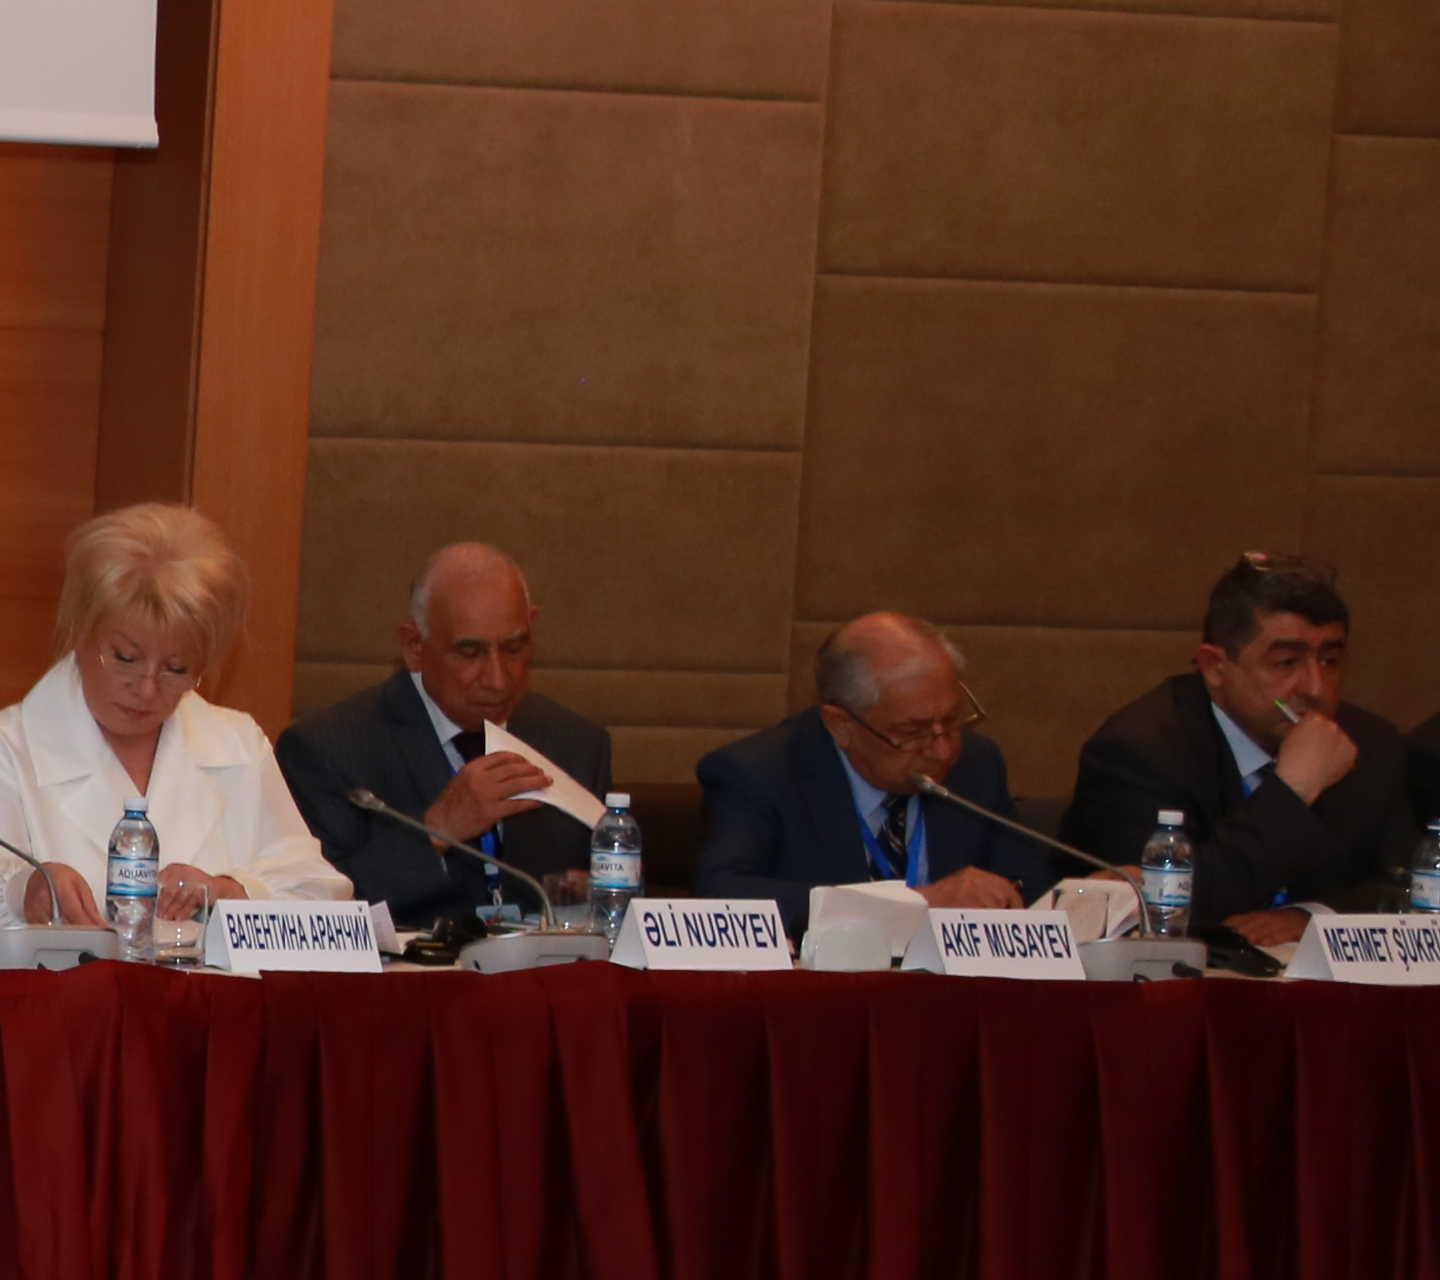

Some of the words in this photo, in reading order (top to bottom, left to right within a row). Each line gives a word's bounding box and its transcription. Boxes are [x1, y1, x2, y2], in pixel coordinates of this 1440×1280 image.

[227, 914, 310, 949] ВАЛЕНТИНА
[310, 907, 373, 949] АРАНЧИЙ
[645, 904, 681, 946] ƏLİ
[683, 905, 777, 947] NURİYEV
[942, 914, 980, 956] AKİF
[983, 924, 1071, 958] MUSAYEV
[1324, 927, 1393, 962] MEHMET
